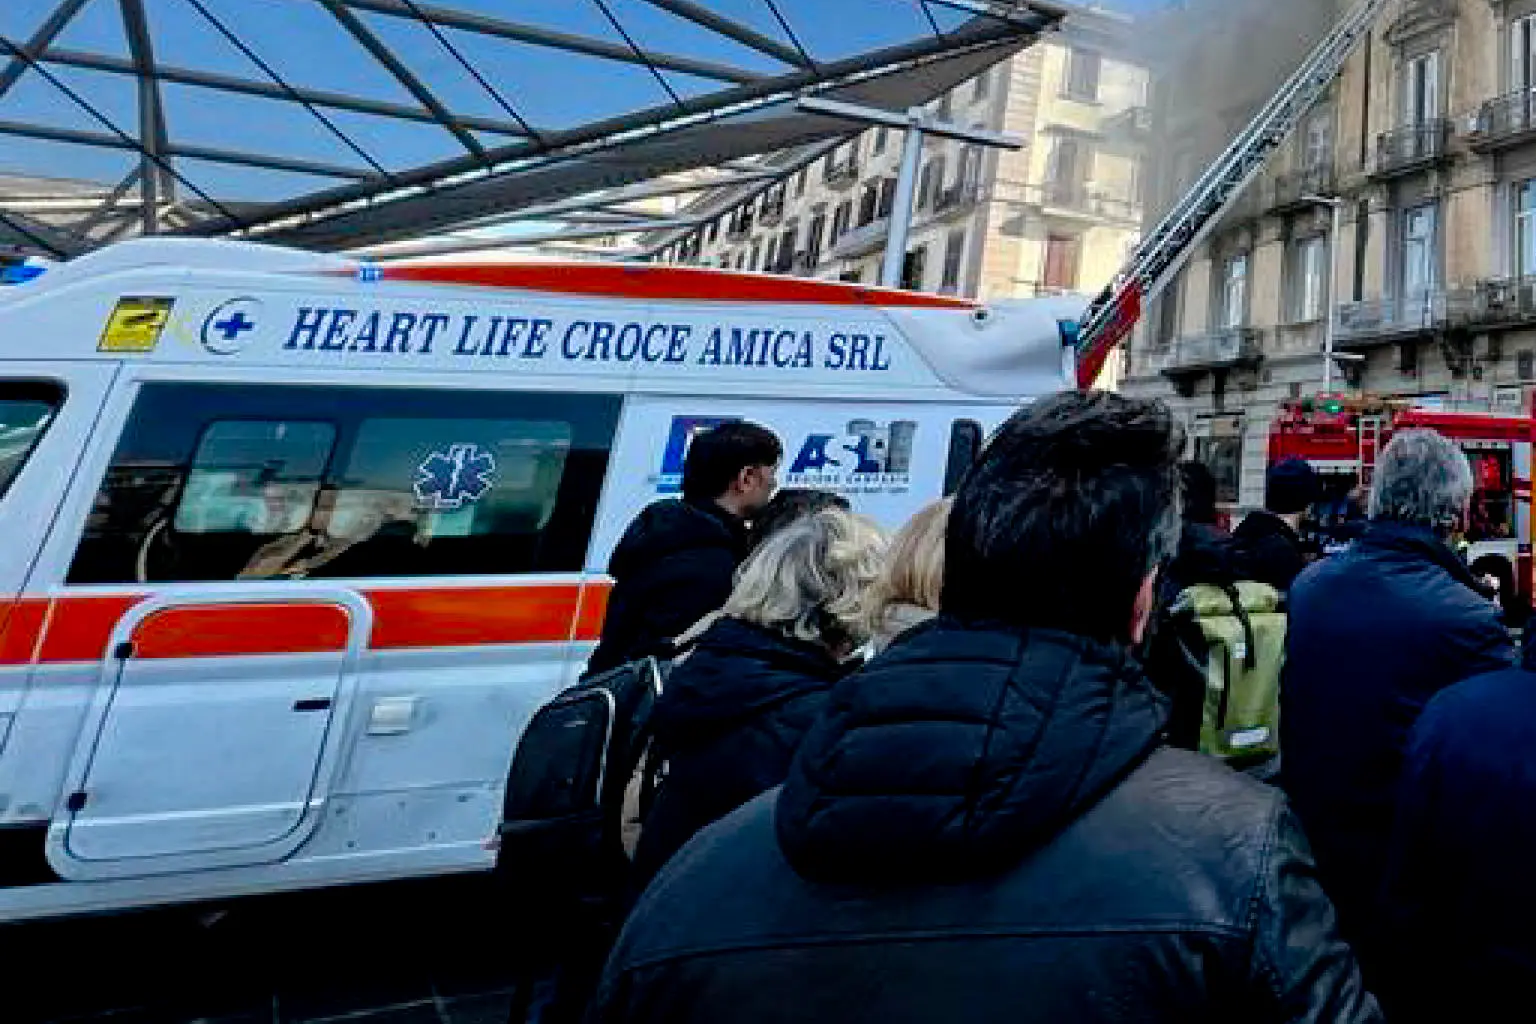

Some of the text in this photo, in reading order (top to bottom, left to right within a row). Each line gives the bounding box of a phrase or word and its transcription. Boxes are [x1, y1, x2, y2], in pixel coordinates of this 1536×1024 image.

[282, 307, 891, 371] HEART LIFE CROCE AMICA SRL
